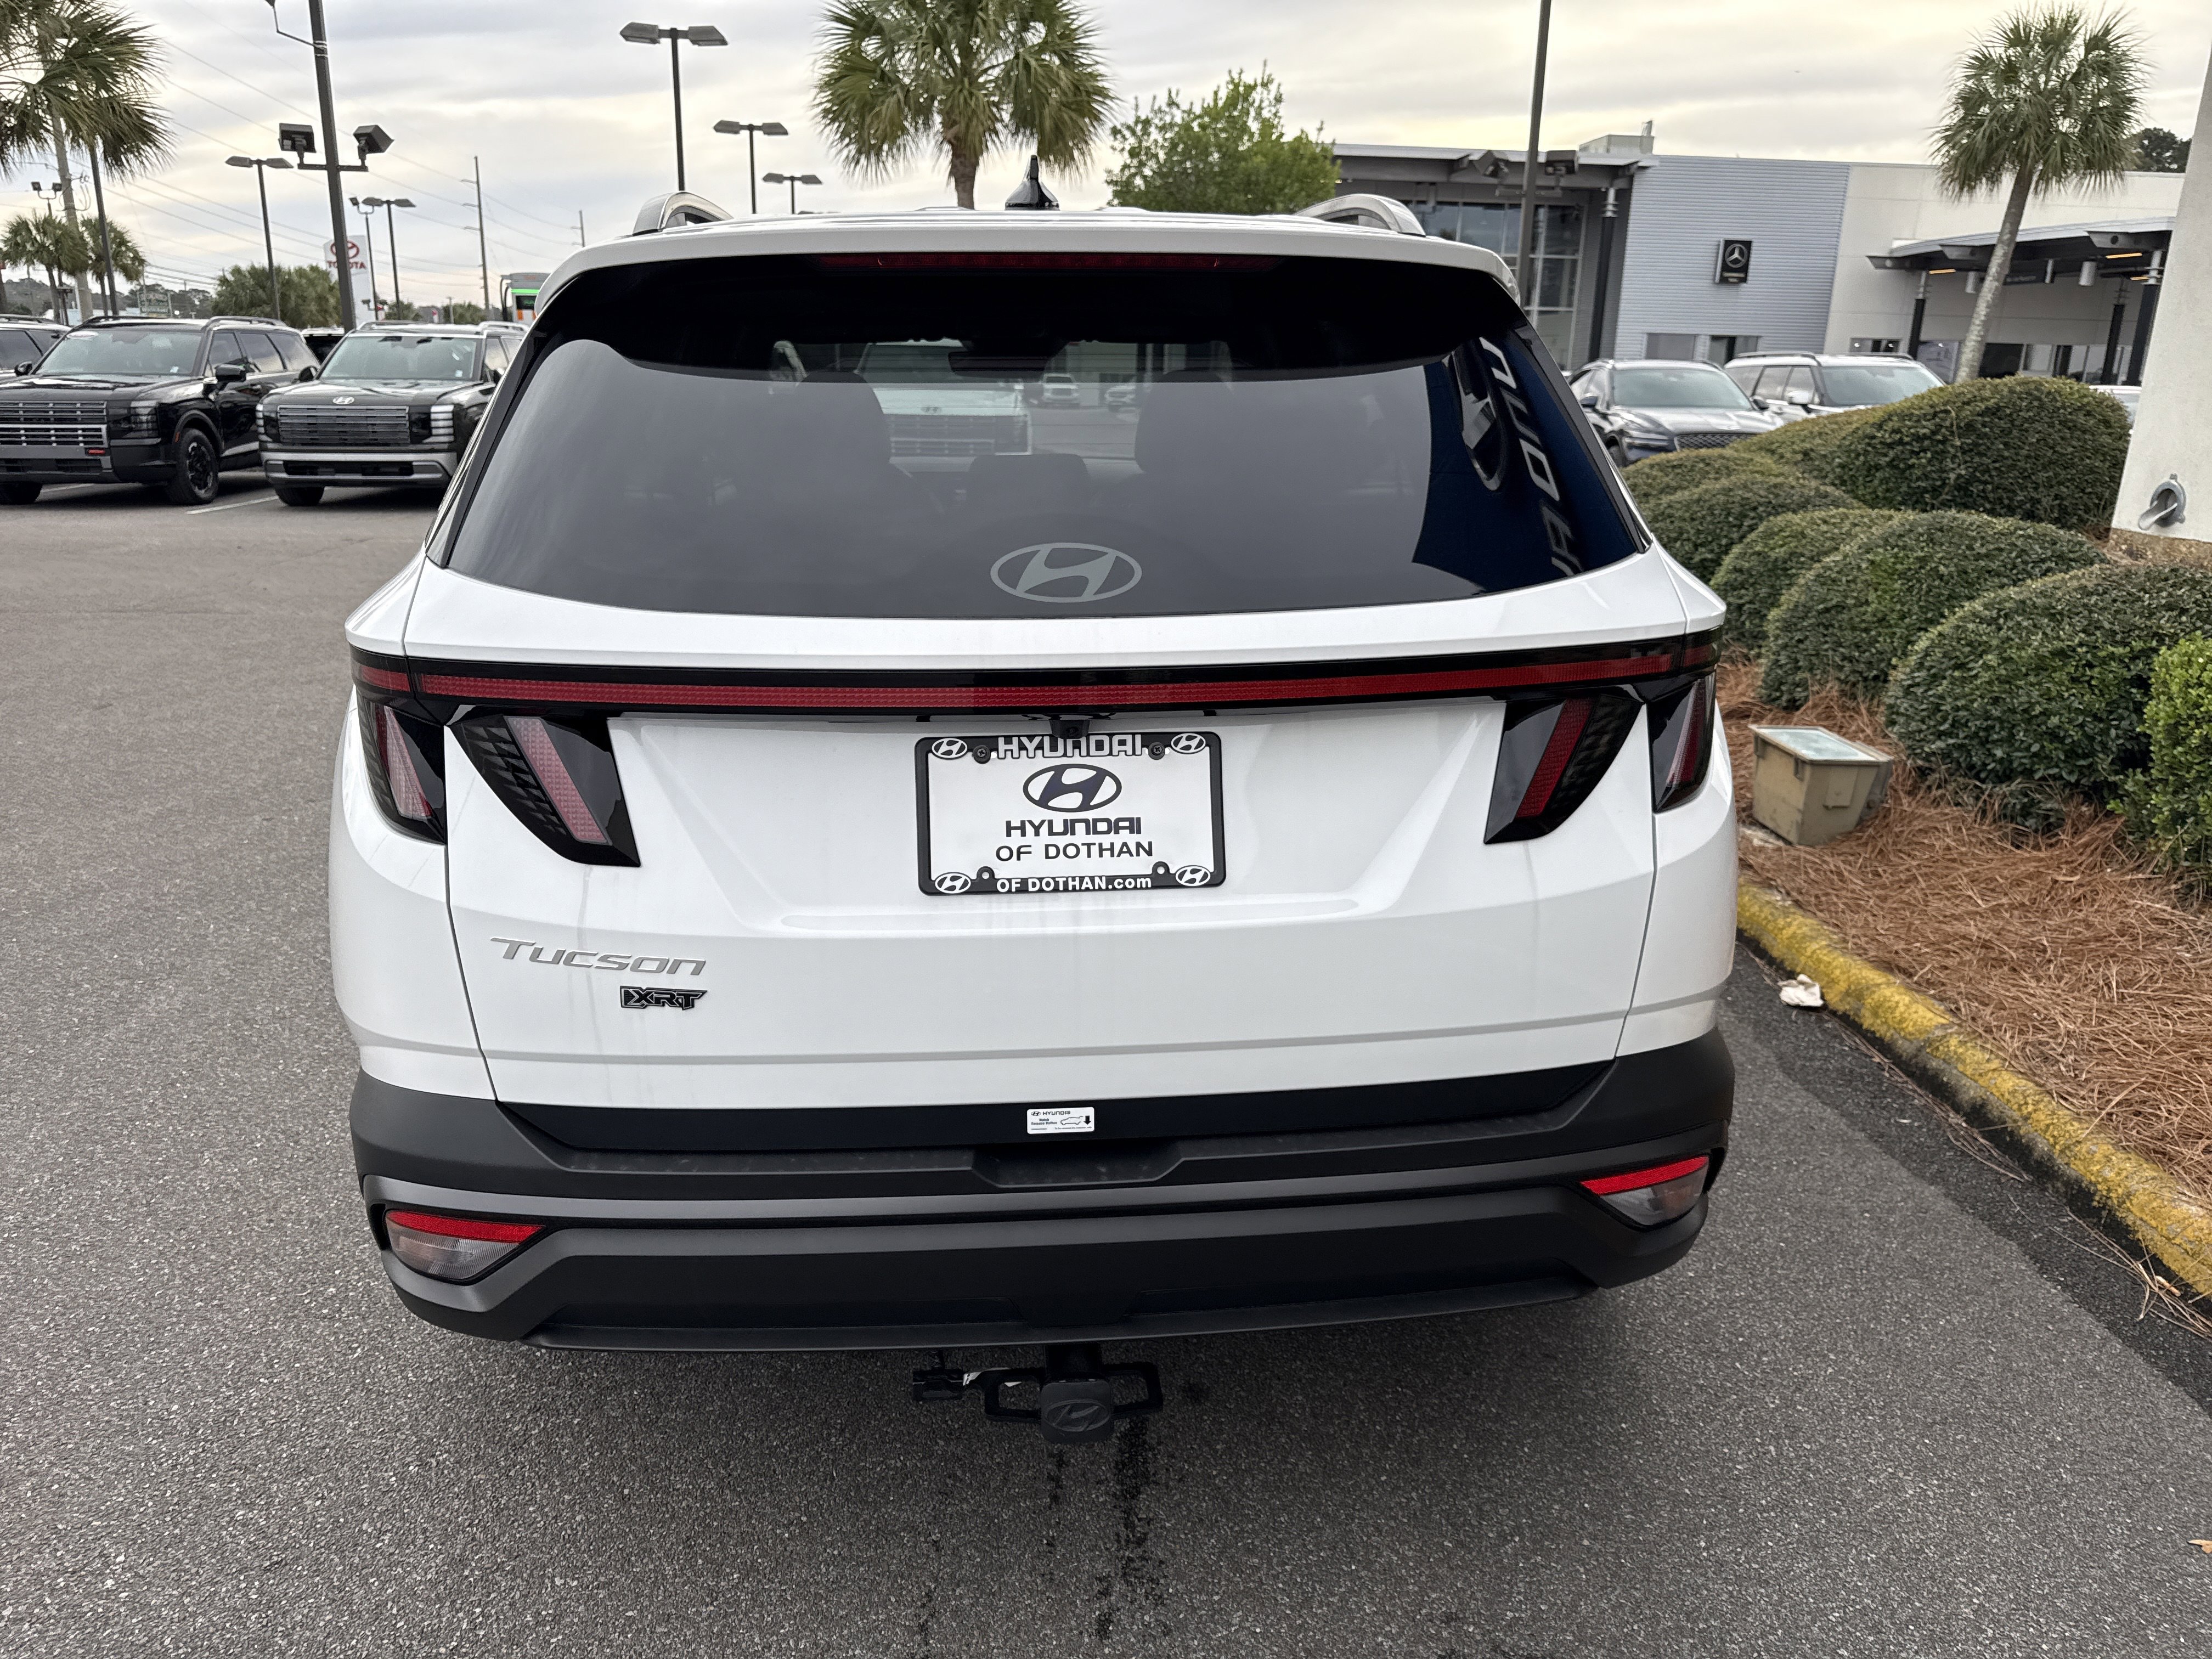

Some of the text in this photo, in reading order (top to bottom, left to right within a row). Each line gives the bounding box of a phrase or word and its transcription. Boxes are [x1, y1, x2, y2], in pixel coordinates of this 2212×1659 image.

[327, 261, 367, 270] TOOTA
[997, 735, 1142, 759] HYUNDAI
[1006, 817, 1142, 838] HYUNDAI
[995, 841, 1153, 862] OF DOTHAN
[996, 875, 1152, 893] OF DOTHAN.com
[627, 988, 706, 1010] XRT
